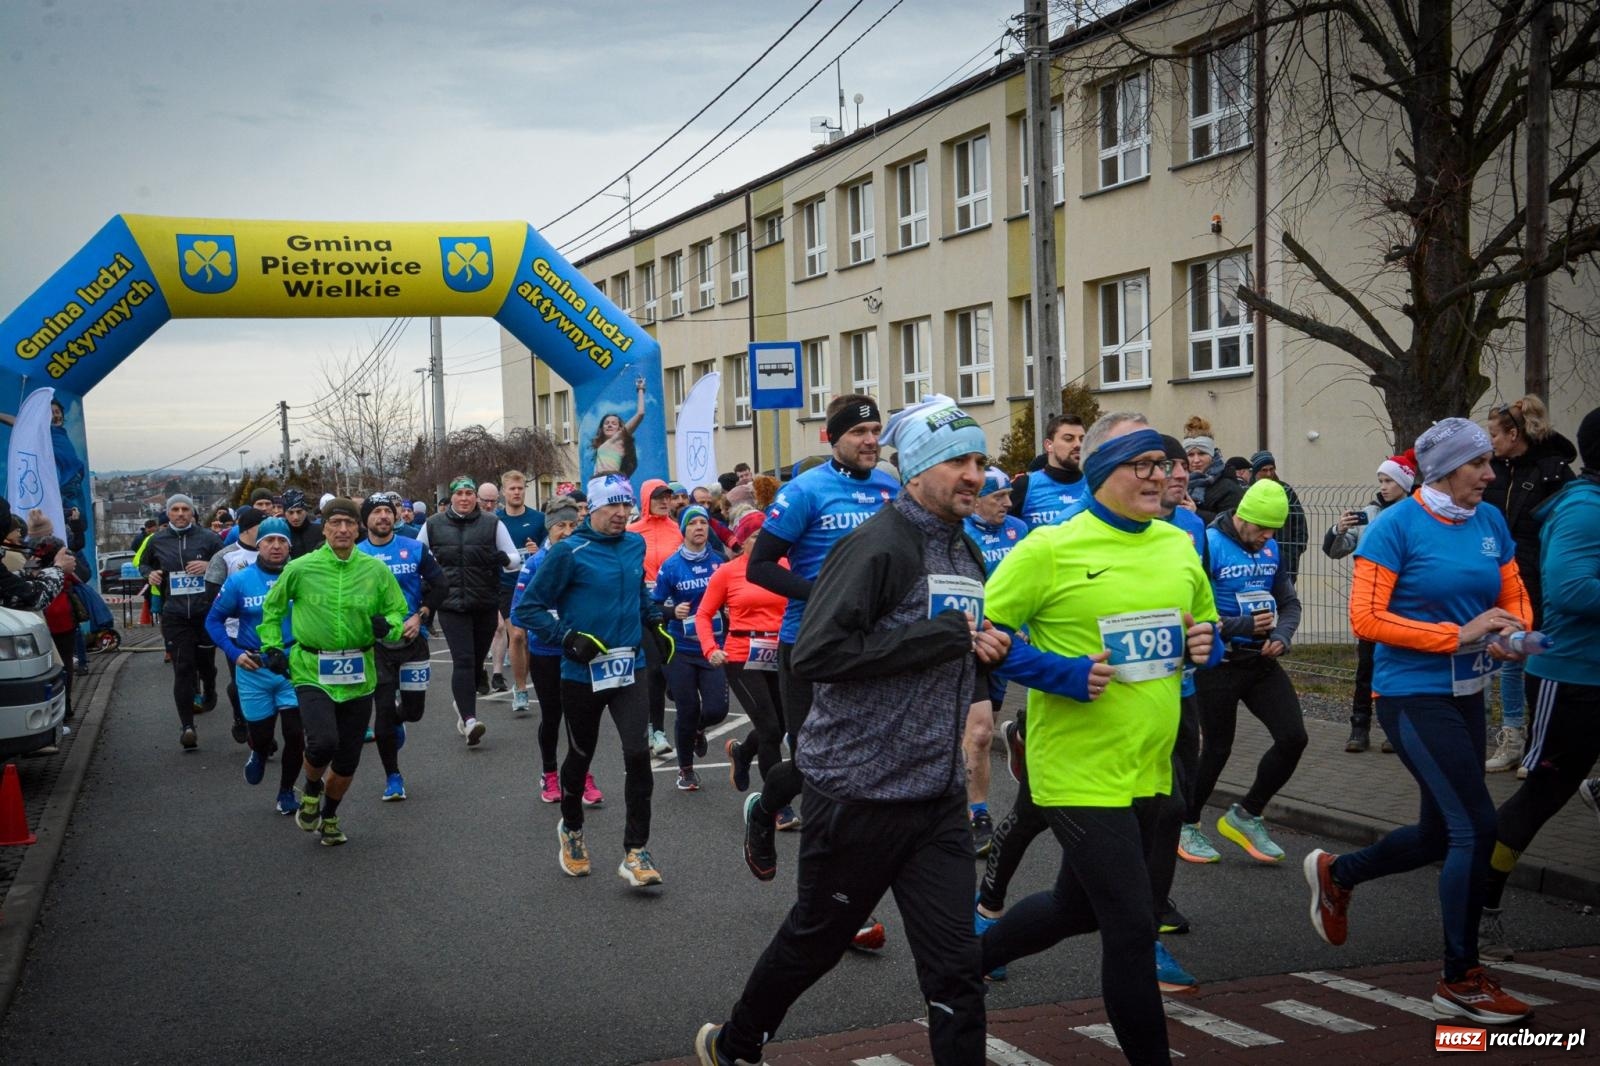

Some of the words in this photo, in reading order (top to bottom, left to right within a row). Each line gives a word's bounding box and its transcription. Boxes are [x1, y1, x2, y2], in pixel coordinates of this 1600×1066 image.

[286, 236, 392, 251] Gmina
[261, 256, 421, 275] Pietrowice
[282, 280, 400, 298] Wielkie
[15, 301, 85, 360] Gmina
[76, 252, 135, 306] ludzi
[531, 257, 587, 312] Gmina
[587, 307, 634, 352] ludzi
[45, 278, 155, 379] aktywnych
[516, 281, 614, 370] aktywnych
[1030, 510, 1061, 524] RU
[176, 577, 200, 588] 196
[243, 595, 266, 608] RU
[1120, 628, 1174, 661] 198
[333, 659, 354, 675] 26
[601, 658, 631, 678] 107
[1471, 650, 1494, 675] 43
[411, 669, 428, 682] 33
